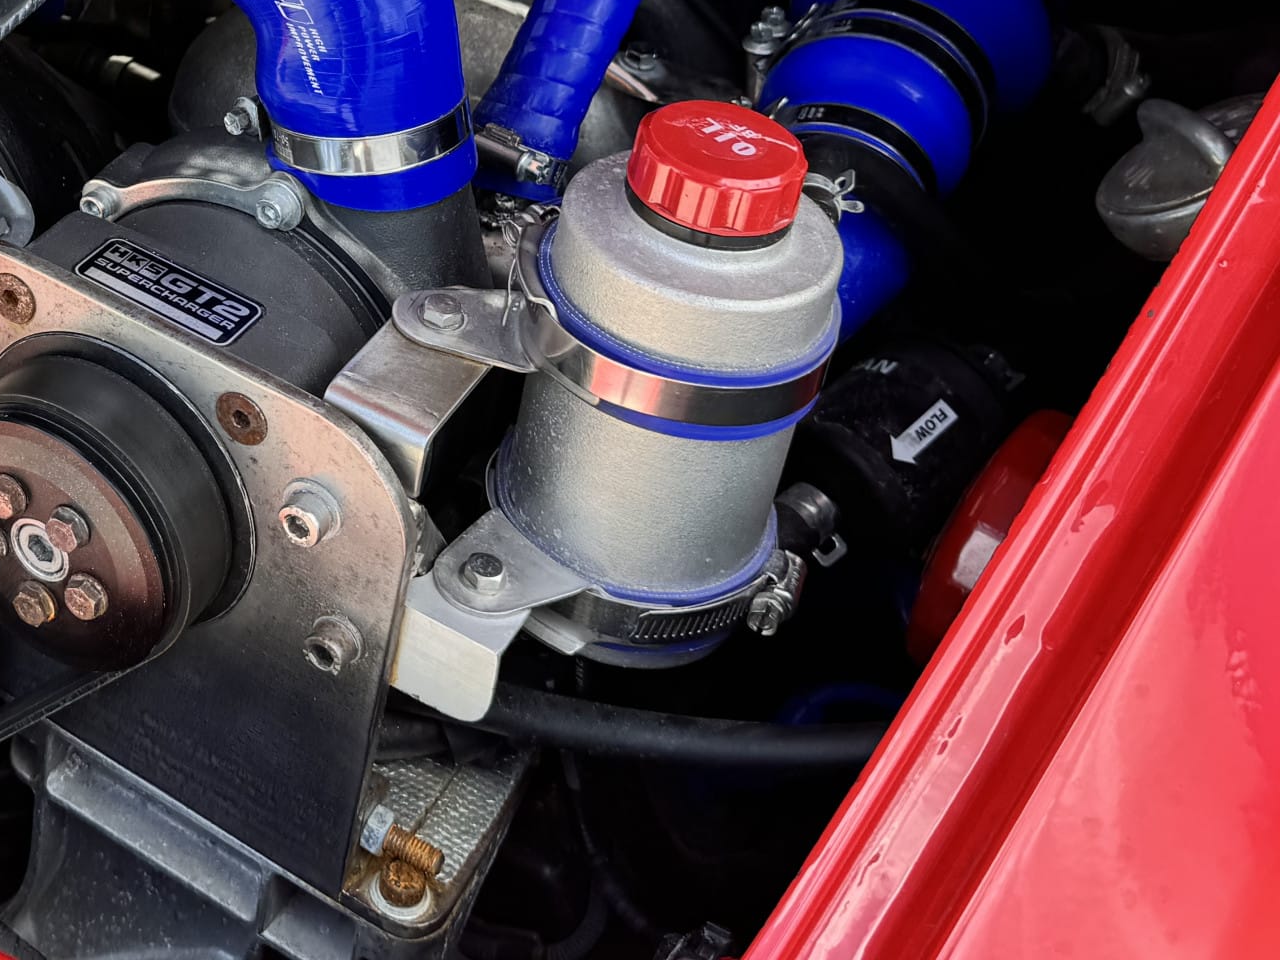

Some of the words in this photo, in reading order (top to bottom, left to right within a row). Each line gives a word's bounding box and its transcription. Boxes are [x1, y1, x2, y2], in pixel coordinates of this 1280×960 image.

[701, 117, 757, 156] OIL
[94, 257, 236, 330] SUPERCHARGER
[102, 243, 169, 281] HKS
[160, 272, 250, 323] GT2
[913, 408, 949, 442] FLOW
